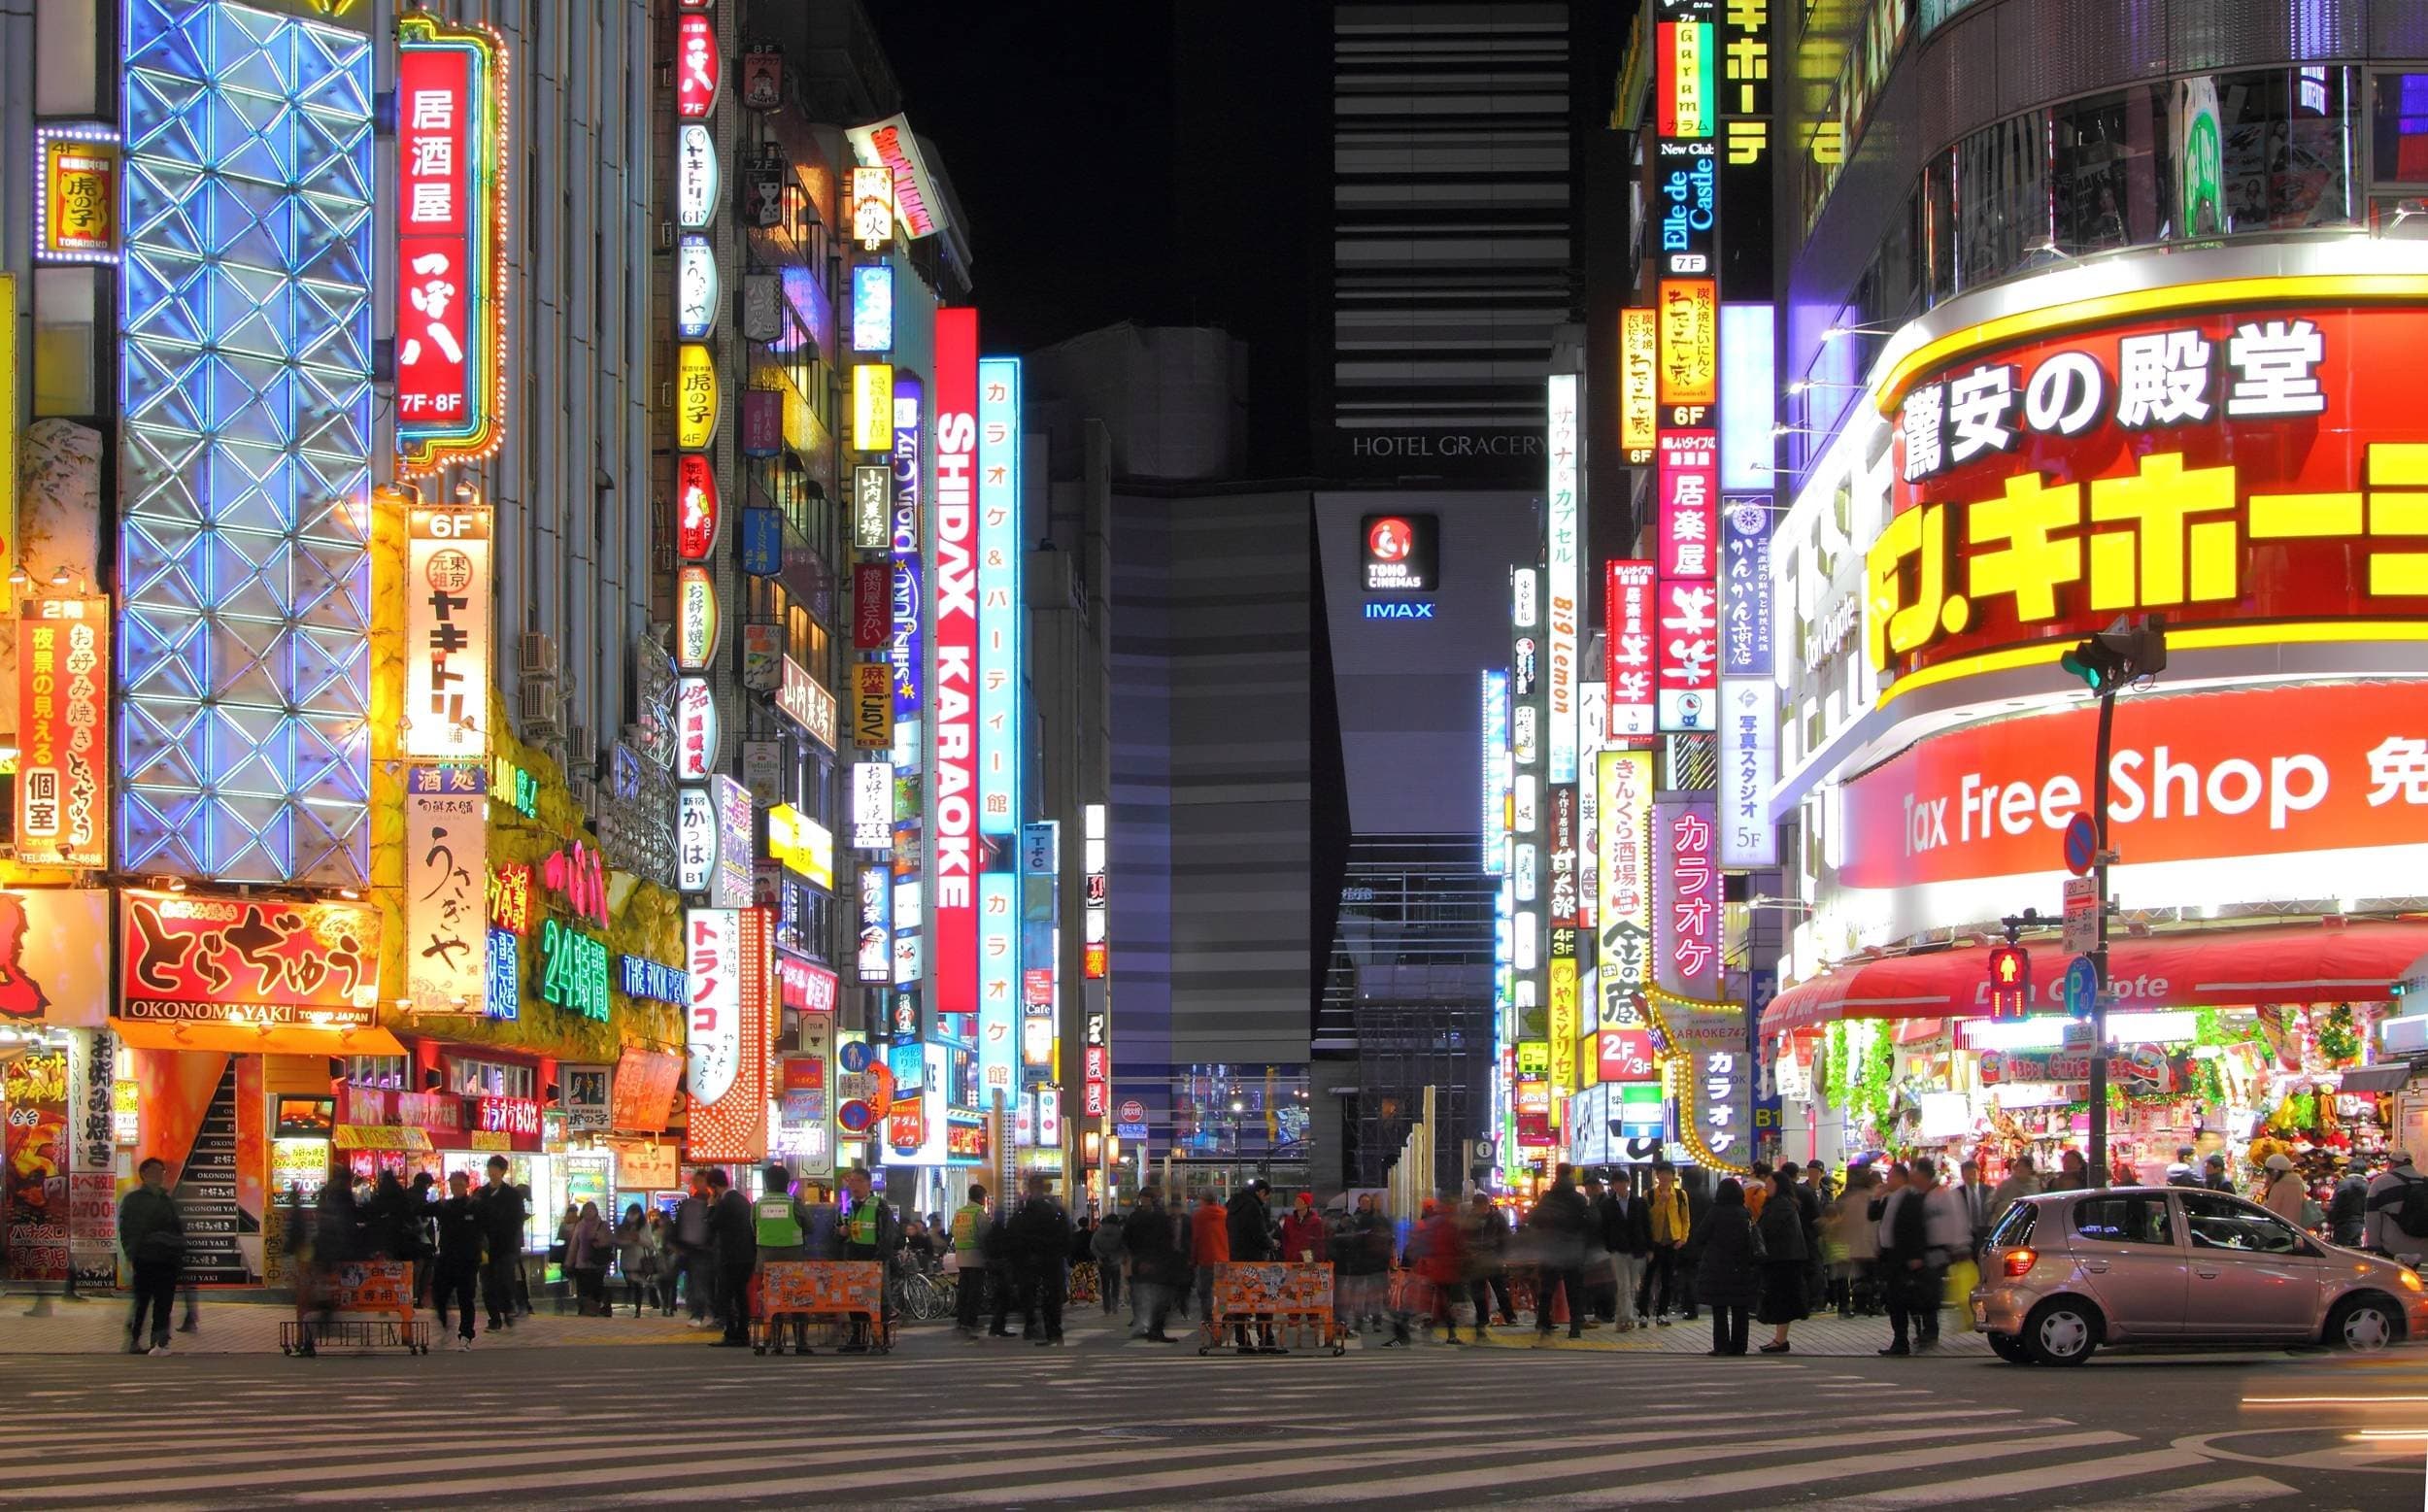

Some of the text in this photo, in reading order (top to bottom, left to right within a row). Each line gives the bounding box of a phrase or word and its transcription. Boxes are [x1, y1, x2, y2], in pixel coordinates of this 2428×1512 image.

[1680, 29, 1698, 112] Garam
[683, 103, 704, 114] 7F
[52, 142, 80, 154] 4F
[412, 89, 454, 223] 居酒屋
[754, 160, 773, 170] 7F
[1661, 144, 1687, 155] New
[67, 177, 99, 227] 虎の子
[1664, 171, 1688, 251] Elle de
[1690, 158, 1713, 230] Castle
[682, 210, 707, 223] 6F
[1676, 258, 1702, 269] 7F
[401, 252, 463, 366] つぼ八
[686, 324, 702, 335] 5F
[684, 374, 711, 424] 虎の子
[1674, 406, 1705, 425] 6F
[1902, 320, 2326, 483] 驚安の殿堂
[682, 433, 701, 444] 4F
[1354, 436, 1547, 456] HOTEL GRACERY
[1631, 450, 1653, 463] 6F
[429, 514, 473, 537] 6F
[1672, 475, 1707, 575] 居楽屋
[432, 556, 449, 588] 元祖
[450, 556, 466, 588] 東京
[1368, 564, 1407, 577] TOHO
[1368, 577, 1422, 588] CINEMAS
[688, 585, 703, 657] お好み焼き
[862, 568, 881, 639] 焼肉屋さかい
[986, 384, 1007, 814] カラオケ&パーティー館
[1366, 603, 1433, 619] IMAX
[1731, 539, 1754, 665] かんかん商店
[892, 573, 918, 682] SHINJUKU
[1805, 593, 1858, 675] Don Quijote
[428, 590, 469, 723] ヤキトリ
[936, 412, 976, 909] SHIDAX KARAOKE
[1553, 595, 1574, 715] Big Lemon
[32, 628, 54, 765] 夜景の見える
[70, 626, 94, 750] お好み焼き
[784, 662, 828, 740] 山内農場
[861, 667, 885, 694] 麻雀
[418, 769, 476, 792] 酒処
[1739, 716, 1758, 818] 写真スタジオ
[28, 772, 55, 830] 個室
[683, 797, 706, 806] 新宿
[1557, 789, 1569, 847] 手作り居酒屋
[1613, 758, 1637, 887] きんくら酒場
[1905, 747, 2330, 857] Tax Free Shop
[1737, 825, 1762, 848] 5F
[686, 870, 704, 883] B1
[862, 870, 884, 924] 海の家
[1550, 847, 1577, 920] 甘太郎
[1673, 815, 1712, 977] カラオケ
[420, 826, 471, 972] うさぎや
[133, 902, 364, 997] とらぢゅう
[1553, 928, 1575, 942] 4F
[1553, 942, 1575, 955] 3F
[692, 921, 718, 1031] トラノコ
[987, 894, 1007, 1085] カラオケ館
[1602, 920, 1650, 1025] 金の蔵
[1973, 982, 2036, 1005] Dn
[132, 1001, 293, 1023] OKONOMI YAKI
[335, 1012, 369, 1023] JAPAN
[1026, 1003, 1051, 1015] Cafe
[2049, 1052, 2132, 1080] Chrisas
[11, 1109, 39, 1126] 全台
[482, 1097, 539, 1135] カラオケBOX
[568, 1114, 609, 1126] 虎の子
[893, 1116, 919, 1126] アダム
[1707, 1052, 1736, 1154] カラオケ
[1756, 1108, 1783, 1127] B1
[896, 1134, 916, 1146] イヴ
